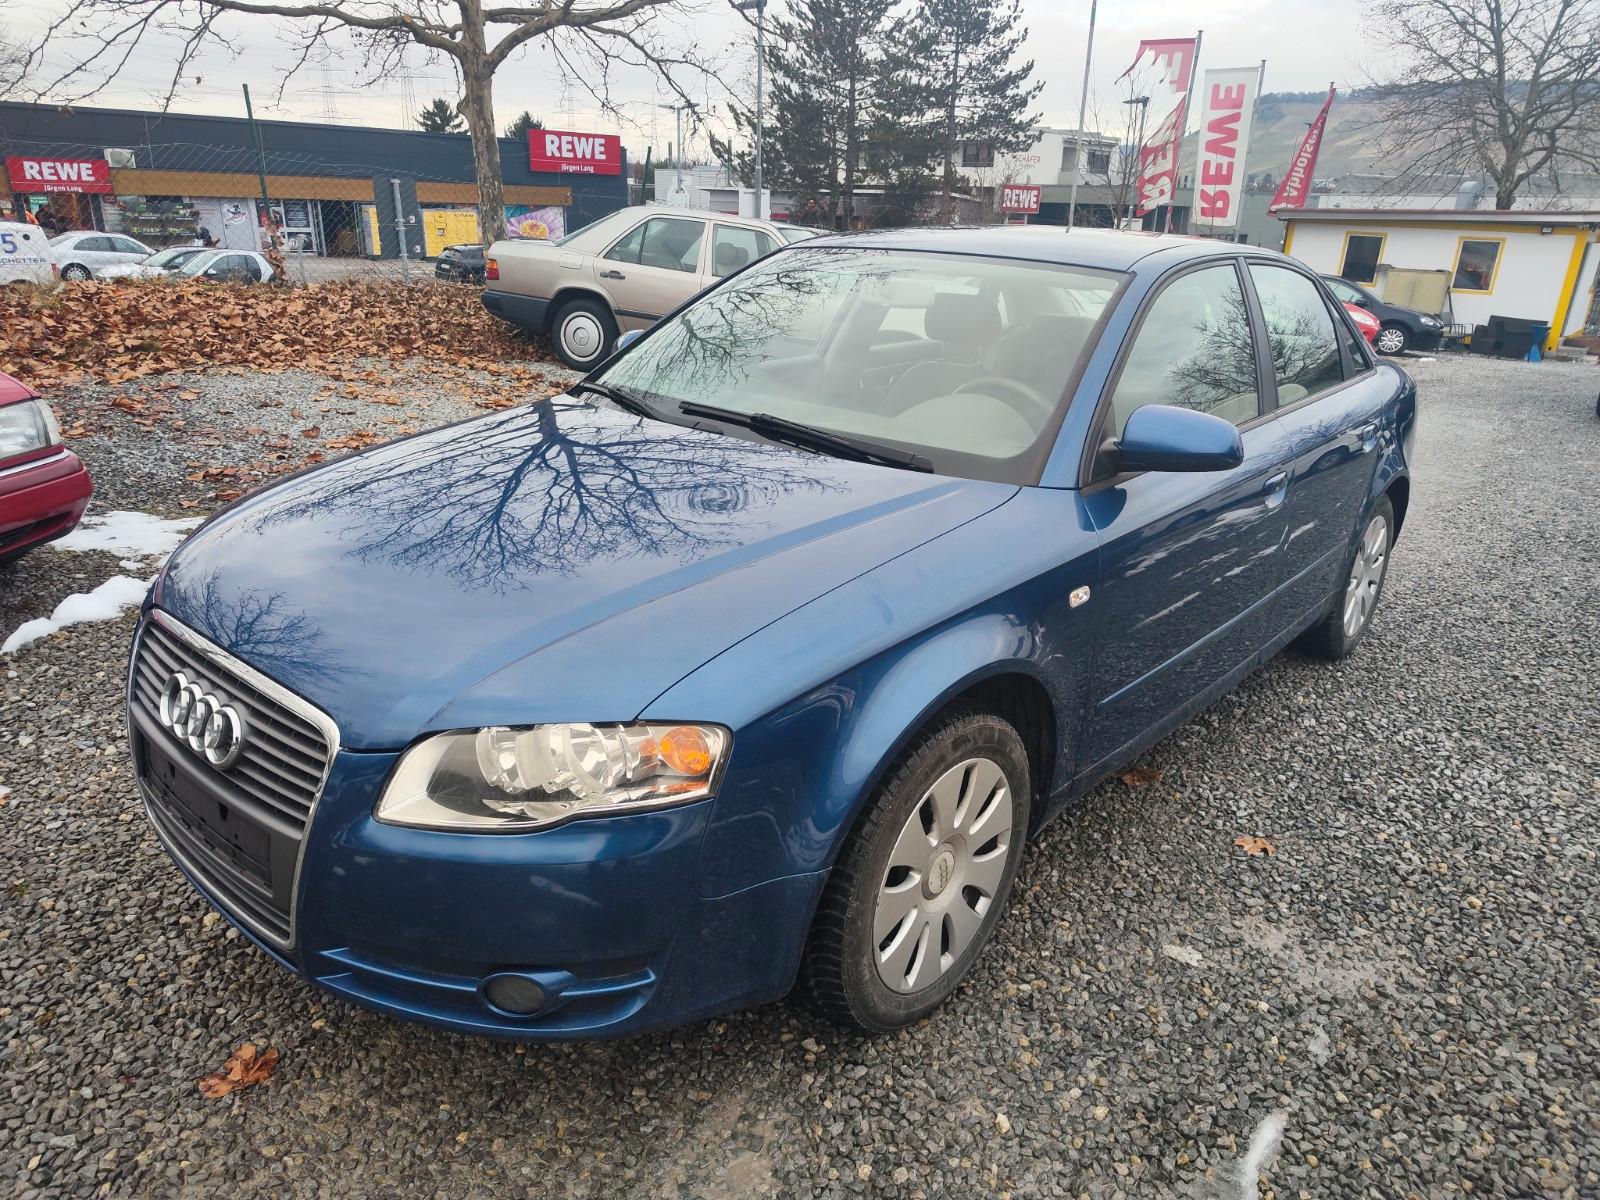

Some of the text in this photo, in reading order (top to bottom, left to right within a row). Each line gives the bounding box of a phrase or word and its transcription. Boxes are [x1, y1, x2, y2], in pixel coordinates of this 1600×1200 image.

[545, 134, 607, 160] REWE
[22, 161, 96, 181] REWE
[561, 163, 594, 173] Jürgen Lang
[44, 184, 83, 193] Jürgen Lang
[1002, 188, 1039, 209] REWE
